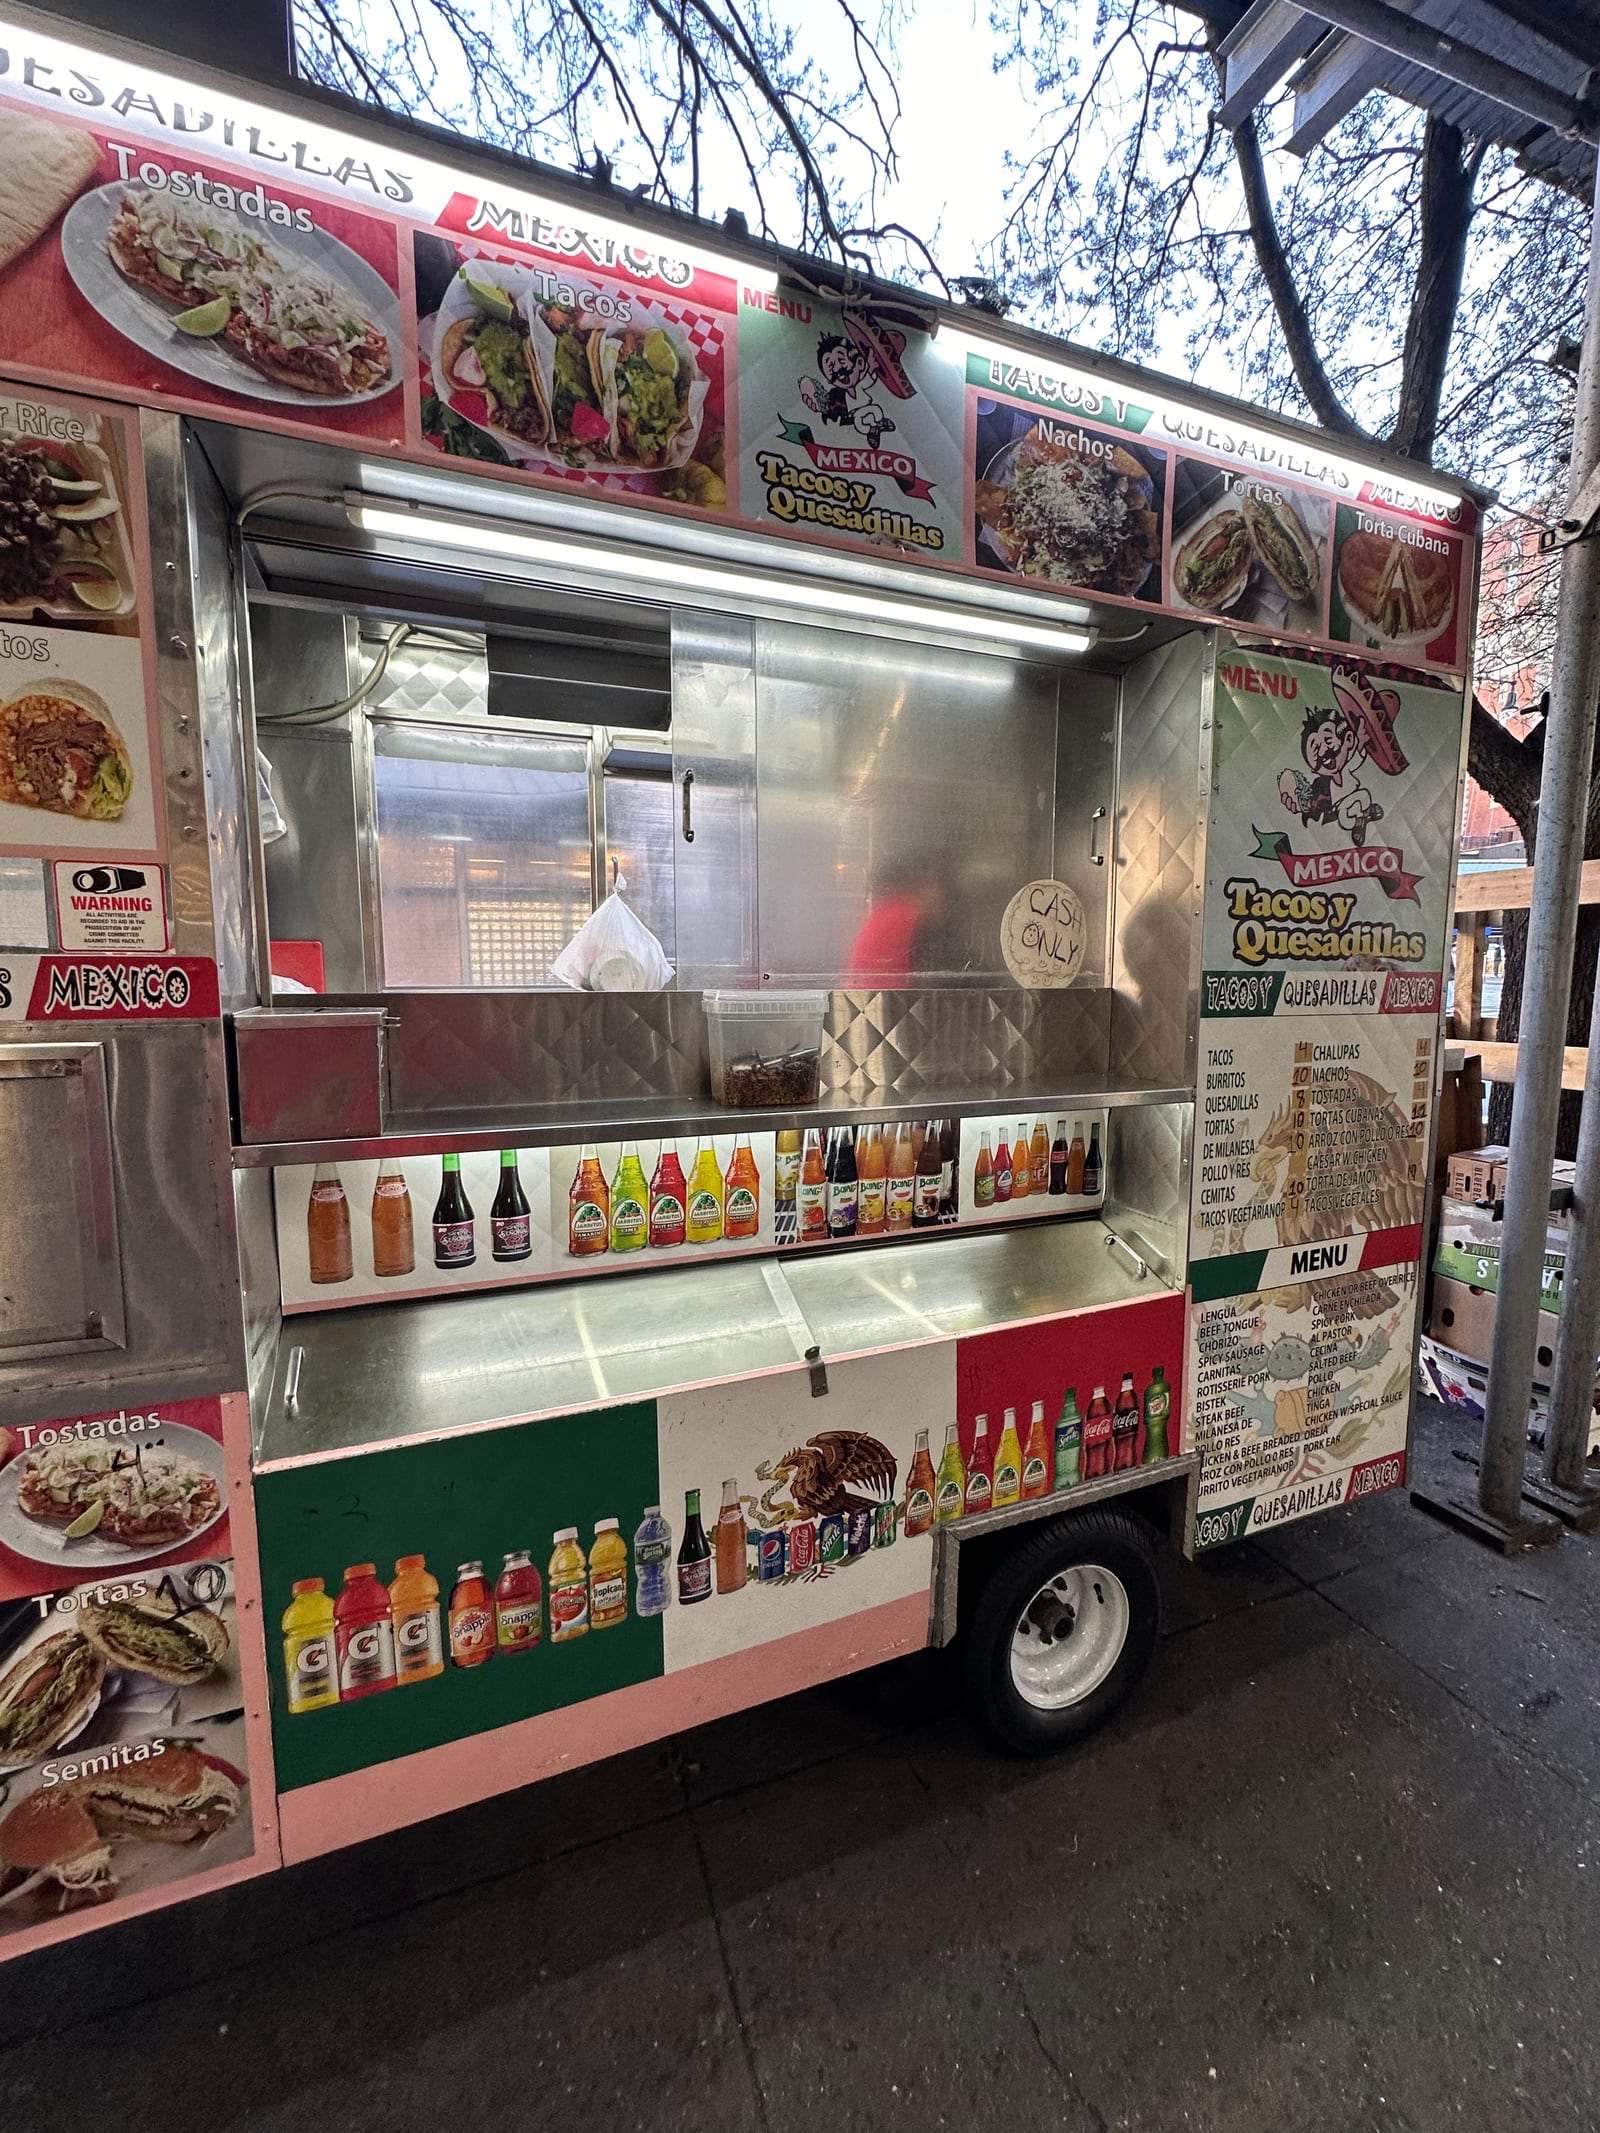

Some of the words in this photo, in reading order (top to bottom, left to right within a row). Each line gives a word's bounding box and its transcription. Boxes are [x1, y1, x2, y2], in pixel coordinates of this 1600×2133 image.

[106, 141, 315, 234] Tostadas
[466, 199, 694, 288] MEXICO
[534, 269, 632, 323] Tacos
[743, 287, 812, 324] MENU
[16, 402, 85, 442] Rice
[989, 358, 1103, 415] TACOS
[1162, 414, 1350, 489] QUESADILLAS
[1369, 481, 1462, 525] MEXICO
[1037, 418, 1114, 460] Nachos
[816, 449, 913, 475] MEXICO
[757, 451, 851, 501] Tacos
[850, 483, 876, 509] y
[1220, 470, 1283, 506] Tortas
[767, 486, 944, 549] Quesadillas
[1356, 511, 1394, 540] Torta
[1398, 524, 1450, 556] Cubana
[1221, 664, 1298, 701] MENU
[1293, 850, 1400, 885] MEXICO
[70, 896, 153, 912] WARNING
[1029, 888, 1082, 932] CASH
[1224, 878, 1331, 923] Tacos
[1331, 894, 1357, 929] y
[1022, 923, 1079, 965] ONLY
[1233, 920, 1427, 966] Quesadillas
[45, 964, 190, 1014] MEXICO
[1207, 976, 1259, 1011] TACOS
[1259, 976, 1273, 1010] Y
[1284, 979, 1377, 1007] QUESADILLAS
[1386, 977, 1436, 1009] MEXICO
[1208, 1049, 1234, 1066] TACOS
[1298, 1041, 1307, 1059] 4
[1313, 1044, 1360, 1061] CHALUPAS
[1420, 1040, 1428, 1056] 4
[1206, 1072, 1246, 1090] BURRITOS
[1292, 1067, 1309, 1087] 10
[1312, 1066, 1350, 1083] NACHOS
[1413, 1061, 1428, 1077] 10
[1205, 1094, 1259, 1115] QUESADILLAS
[1296, 1090, 1305, 1109] 8
[1311, 1088, 1357, 1105] TOSTADAS
[1204, 1119, 1235, 1136] TORTAS
[1293, 1111, 1305, 1128] 10
[1310, 1110, 1344, 1127] TORTAS
[1345, 1106, 1385, 1123] CUBANAS
[1308, 1132, 1338, 1148] ARROZ
[1340, 1130, 1358, 1145] CON
[1360, 1127, 1385, 1143] POLLO
[1395, 1124, 1409, 1139] RES
[1407, 1122, 1424, 1138] 10
[1203, 1143, 1214, 1159] DE
[1215, 1139, 1255, 1158] MILANESA
[1287, 1133, 1304, 1153] 10
[1202, 1164, 1228, 1182] POLLO
[1229, 1164, 1235, 1179] Y
[1236, 1162, 1251, 1178] RES
[1307, 1153, 1340, 1170] CAESAR
[1289, 1180, 1304, 1196] 10
[1306, 1175, 1334, 1192] TORTA
[1336, 1173, 1346, 1187] DE
[1346, 1170, 1378, 1187] JAMON
[1200, 1186, 1235, 1205] CEMITAS
[1304, 1196, 1333, 1213] TACOS
[1335, 1189, 1380, 1209] VEGETALES
[1200, 1210, 1226, 1228] TACOS
[1227, 1201, 1286, 1223] VEGETARIANOP
[1290, 1199, 1299, 1219] 4
[1290, 1243, 1348, 1276] MENU
[1313, 1286, 1347, 1302] CHICKEN
[1347, 1285, 1359, 1295] OR
[1360, 1279, 1377, 1292] BEEF
[1378, 1275, 1398, 1288] OVER
[1399, 1272, 1415, 1284] RICE
[1200, 1307, 1237, 1323] LENGUA
[1312, 1302, 1340, 1316] CARNE
[1340, 1292, 1381, 1310] ENCHILADA
[1200, 1324, 1222, 1339] BEEF
[1223, 1316, 1260, 1333] TONGUE
[1311, 1316, 1333, 1330] SPICY
[1335, 1311, 1356, 1325] PORK
[1199, 1335, 1239, 1353] CHORIZO
[1311, 1333, 1320, 1343] AL
[1322, 1325, 1353, 1341] PASTOR
[1198, 1353, 1224, 1369] SPICY
[1225, 1344, 1265, 1362] SAUSAGE
[1309, 1356, 1338, 1371] SALTED
[1340, 1351, 1358, 1364] BEEF
[1310, 1343, 1338, 1358] CECINA
[1196, 1377, 1246, 1398] ROTISSERIE
[1247, 1371, 1271, 1386] PORK
[1197, 1364, 1241, 1383] CARNITAS
[1308, 1370, 1334, 1385] POLLO
[1307, 1382, 1341, 1399] CHICKEN
[1195, 1411, 1223, 1427] STEAK
[1225, 1405, 1246, 1420] BEEF
[1196, 1396, 1227, 1413] BISTEK
[1305, 1409, 1339, 1427] CHICKEN
[1340, 1398, 1379, 1416] W/SPECIAL
[1380, 1391, 1404, 1406] SAUCE
[1307, 1398, 1330, 1413] TINGA
[16, 1410, 162, 1450] Tostadas
[1195, 1422, 1240, 1442] MILANESA
[1241, 1418, 1253, 1430] DE
[1225, 1434, 1241, 1449] RES
[1304, 1425, 1329, 1440] OREJA
[1233, 1449, 1239, 1460] &
[1241, 1443, 1261, 1458] BEEF
[1262, 1432, 1301, 1451] BREADED
[1303, 1439, 1324, 1453] PORK
[1325, 1434, 1341, 1447] EAR
[1223, 1462, 1243, 1475] CON
[1244, 1453, 1271, 1470] POLLO
[1279, 1446, 1294, 1460] RES
[1231, 1460, 1294, 1487] VEGETARIANOP
[1231, 1505, 1244, 1536] Y
[1253, 1477, 1343, 1526] QUESADILLAS
[1353, 1458, 1399, 1495] MEXICO
[821, 1523, 841, 1557] Sprite
[31, 1578, 148, 1619] Tortas
[594, 1583, 624, 1599] Tropicana
[398, 1614, 429, 1647] G
[453, 1611, 492, 1638] Snapple
[348, 1626, 380, 1660] G
[296, 1639, 330, 1674] G
[41, 1738, 167, 1789] Semitas
